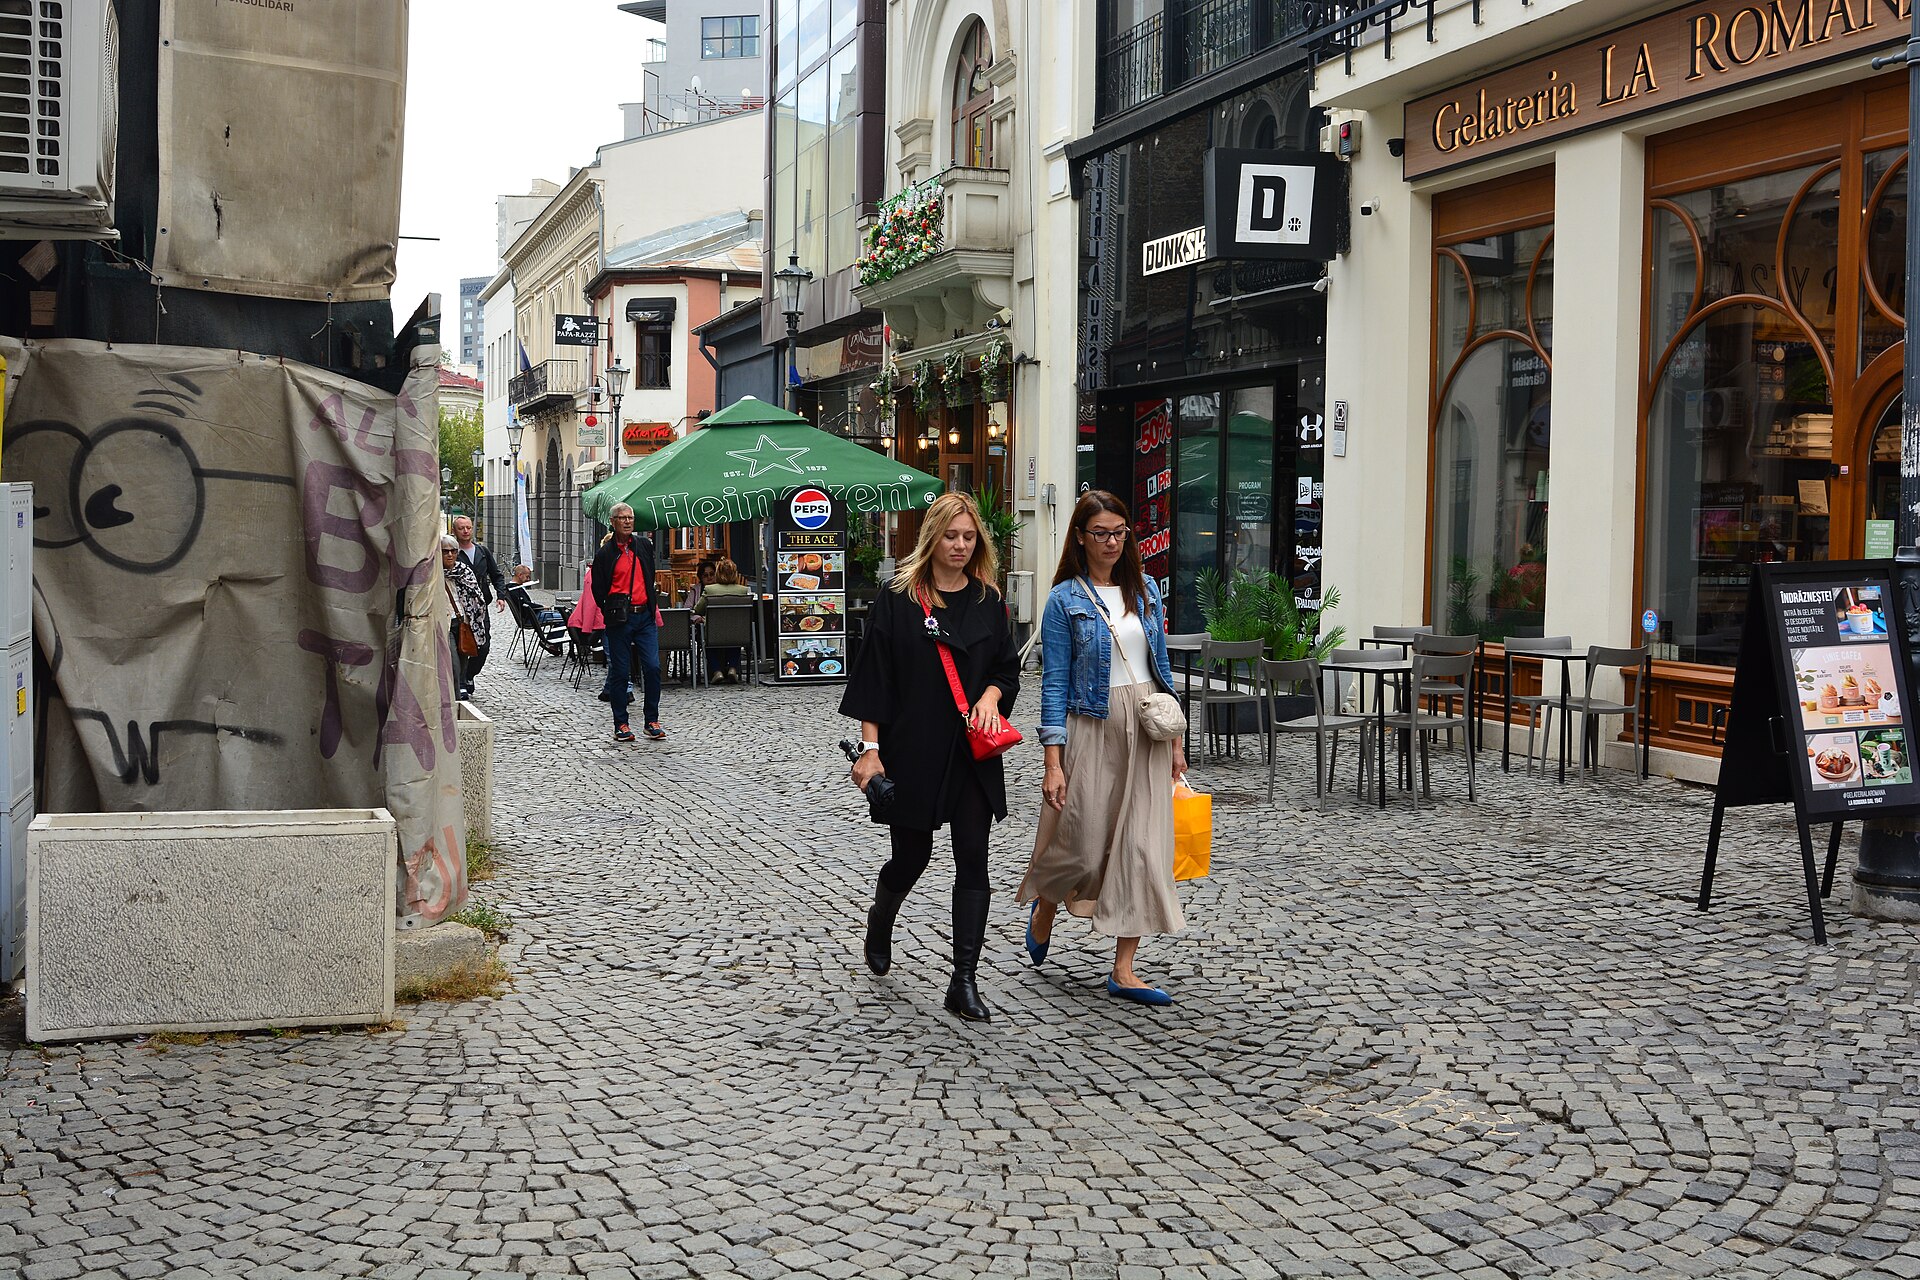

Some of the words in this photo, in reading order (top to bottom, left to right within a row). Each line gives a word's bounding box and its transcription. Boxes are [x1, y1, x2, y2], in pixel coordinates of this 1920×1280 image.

[228, 0, 294, 12] SOLIDĂRI
[1432, 71, 1579, 153] Gelateria
[1597, 42, 1659, 107] LA
[646, 479, 916, 530] Heinen
[794, 505, 829, 514] PEPSI
[789, 535, 811, 544] THE
[813, 535, 835, 544] ACE
